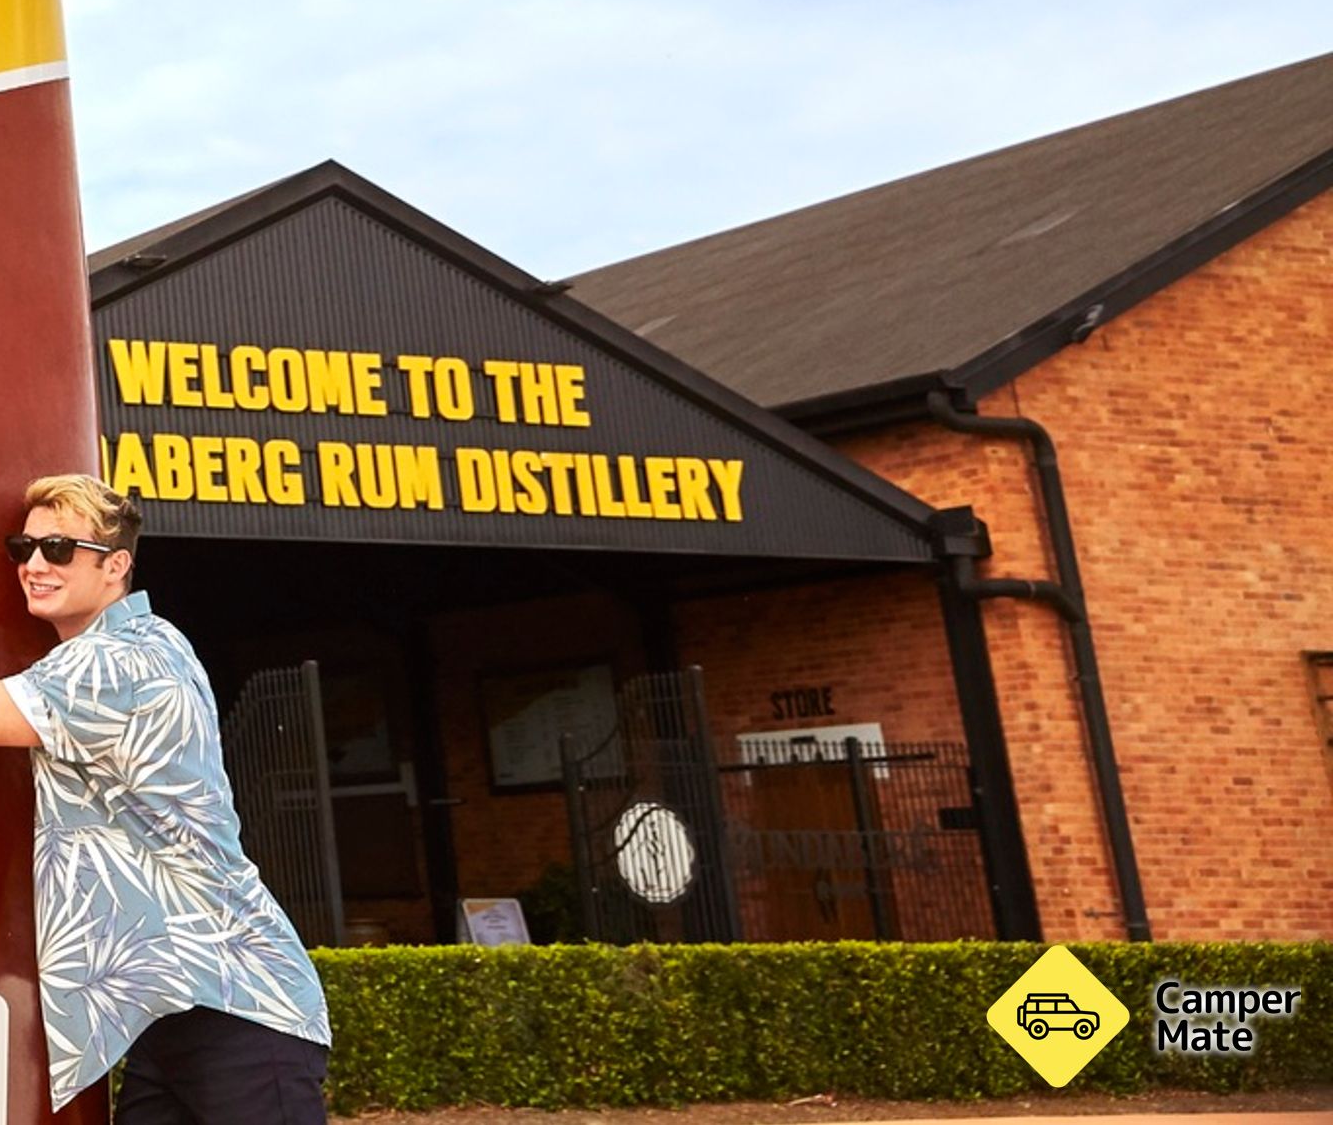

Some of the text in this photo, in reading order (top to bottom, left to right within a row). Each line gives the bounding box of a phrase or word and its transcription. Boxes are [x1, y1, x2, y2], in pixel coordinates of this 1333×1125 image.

[108, 338, 592, 428] WELCOME TO THE
[100, 432, 744, 523] ABERG RUM DISTILLERY
[771, 686, 836, 721] STORE
